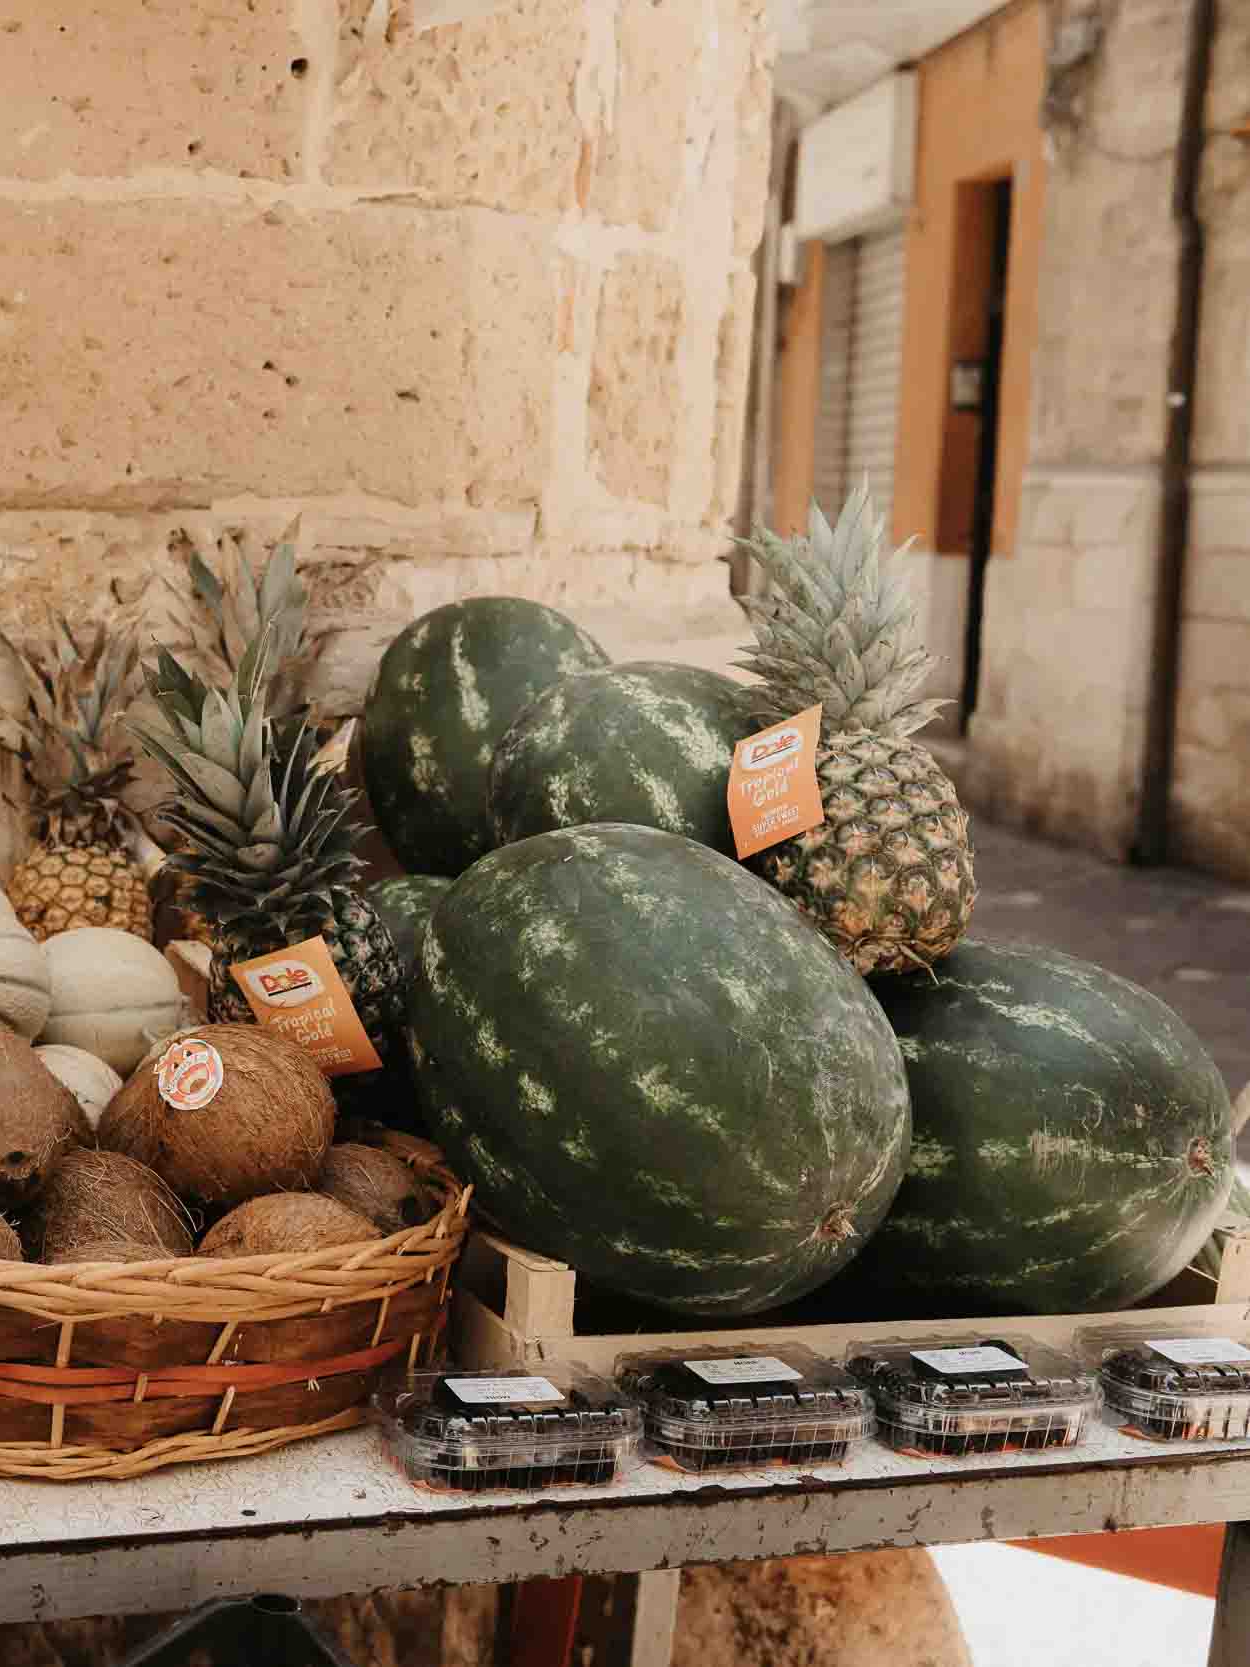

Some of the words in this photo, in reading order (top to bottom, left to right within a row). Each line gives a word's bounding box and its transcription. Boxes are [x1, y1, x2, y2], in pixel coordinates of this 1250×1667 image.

[751, 735, 798, 760] Dole
[258, 967, 311, 993] Dole
[270, 996, 334, 1033] Tropical
[296, 1018, 334, 1042] Gold
